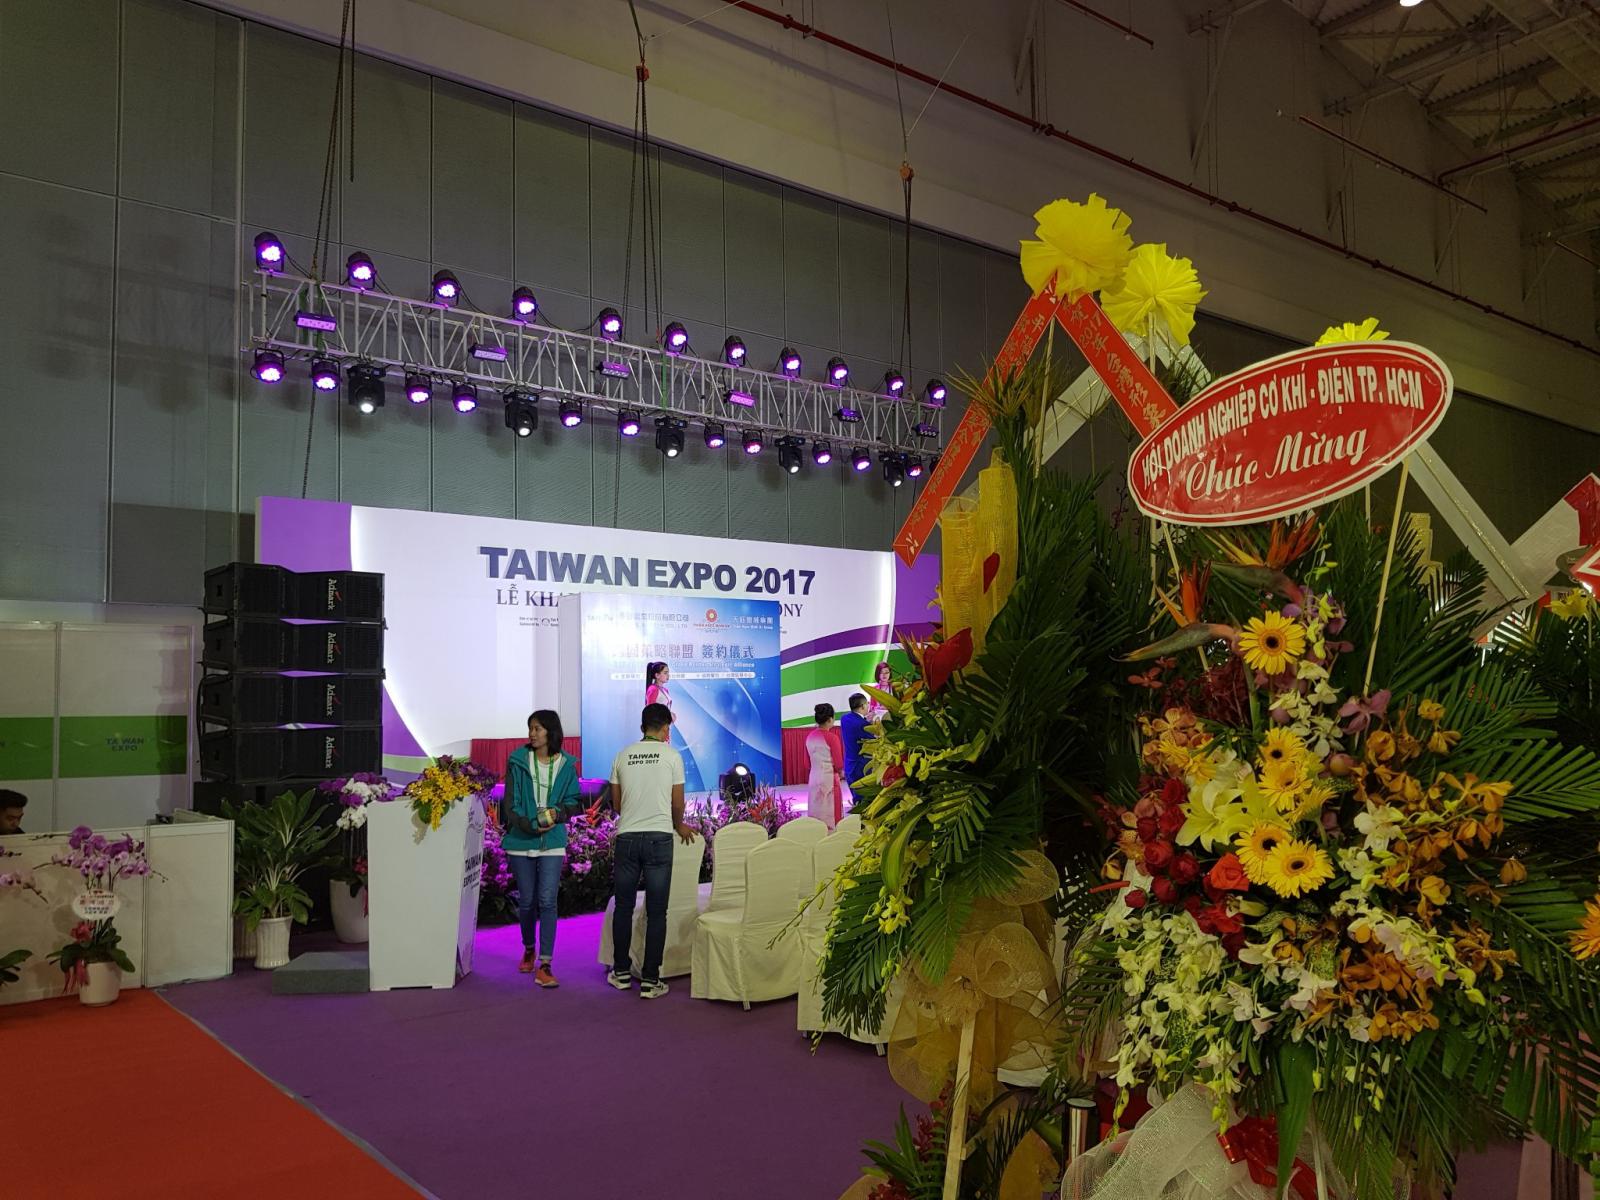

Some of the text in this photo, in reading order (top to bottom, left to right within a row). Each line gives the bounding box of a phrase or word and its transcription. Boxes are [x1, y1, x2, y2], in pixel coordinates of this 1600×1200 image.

[1141, 440, 1163, 491] HỘI
[1163, 415, 1206, 466] DOANH
[1208, 385, 1256, 437] NGHIỆP
[1259, 373, 1280, 419] CƠ
[1281, 363, 1308, 413] KHÍ
[1317, 358, 1355, 415] ĐIỆN
[1357, 366, 1383, 403] TP.
[1385, 367, 1425, 411] HCM
[1185, 427, 1371, 501] Chúc Mừng
[479, 546, 816, 595] TAIWAN EXPO 2017
[328, 579, 337, 610] Admark
[496, 583, 559, 607] LỄ KH
[327, 632, 337, 664] Admark
[326, 684, 336, 716] Admark
[325, 736, 335, 768] Admark
